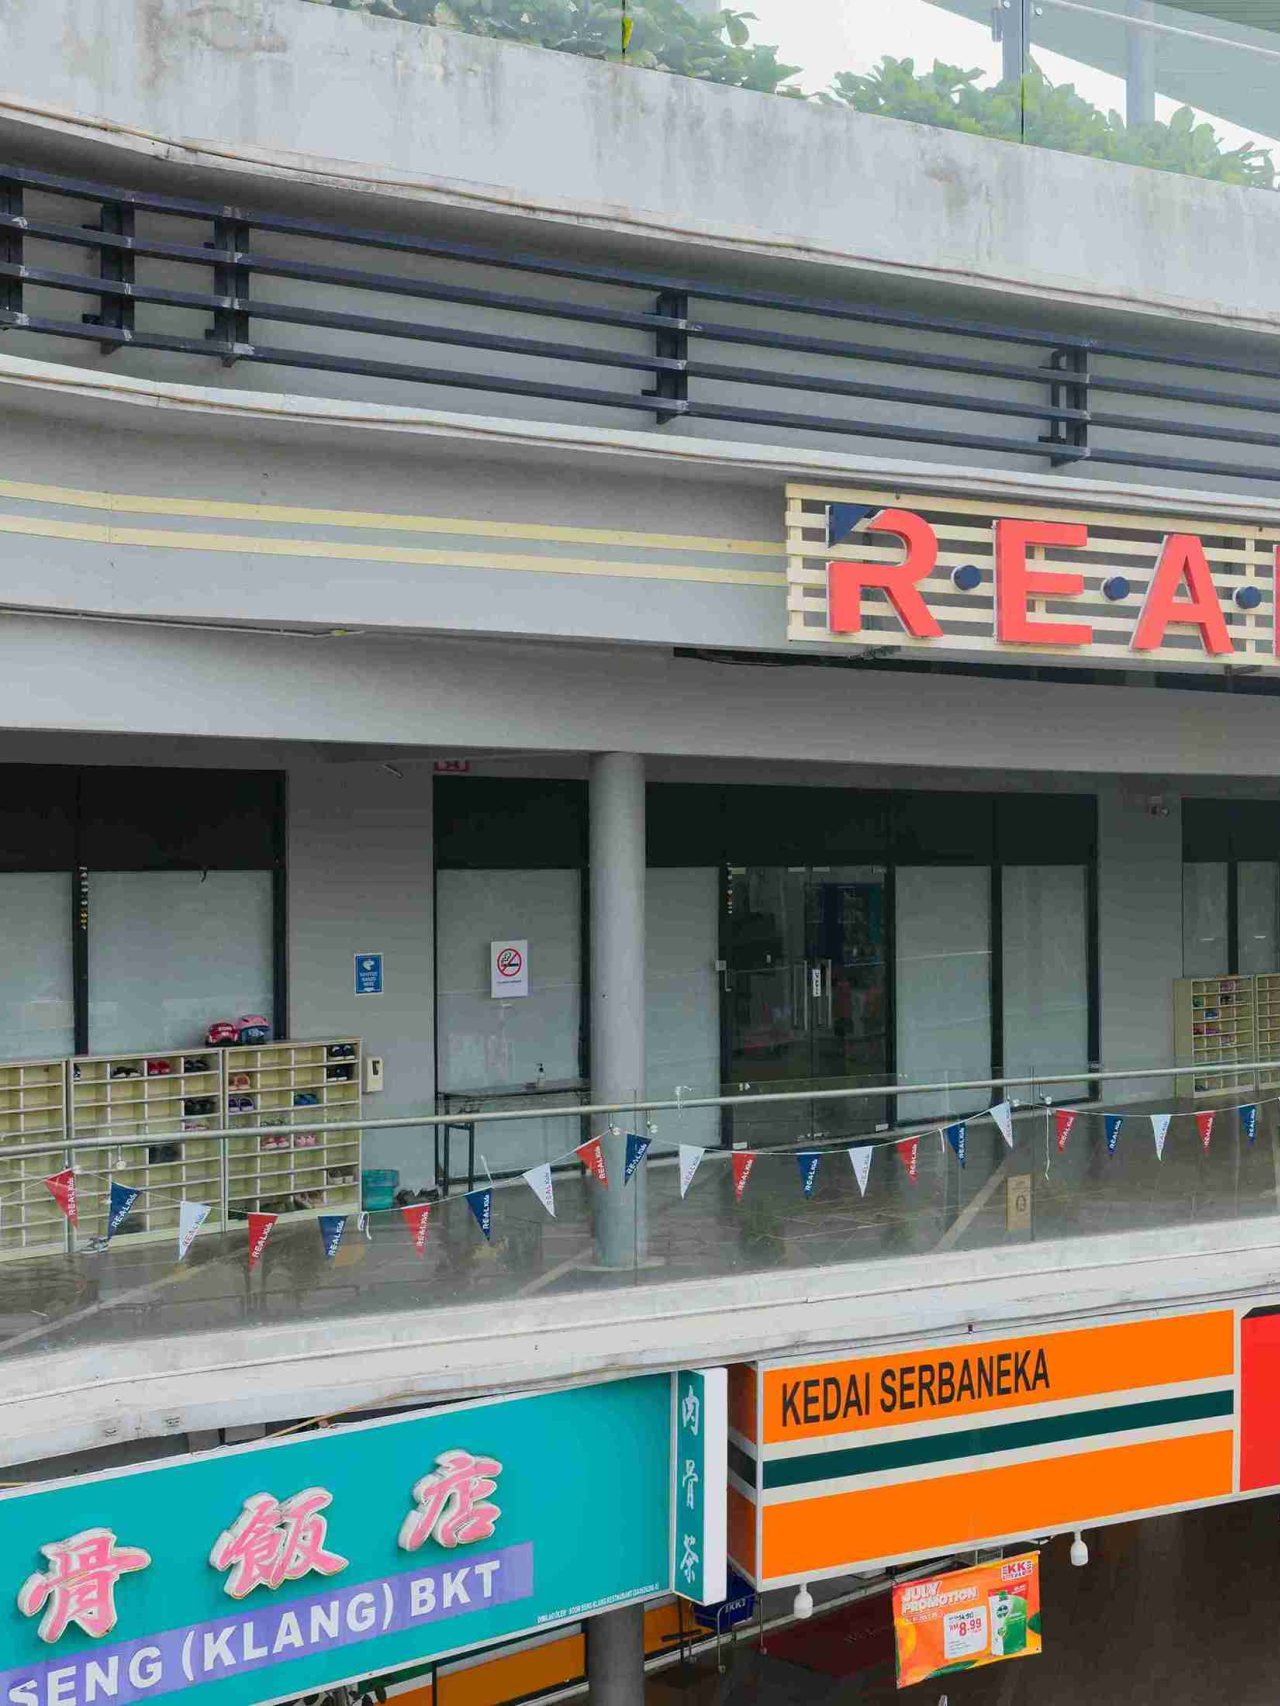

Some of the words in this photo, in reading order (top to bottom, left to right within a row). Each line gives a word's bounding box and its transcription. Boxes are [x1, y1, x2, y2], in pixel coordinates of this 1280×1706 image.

[782, 1371, 870, 1427] KEDAI
[880, 1348, 1050, 1413] SERBANEKA
[903, 1580, 941, 1602] JULY
[903, 1586, 978, 1614] PROMOTION
[9, 1646, 162, 1705] SENG
[182, 1583, 394, 1681] (KLANG)
[409, 1559, 501, 1619] BKT
